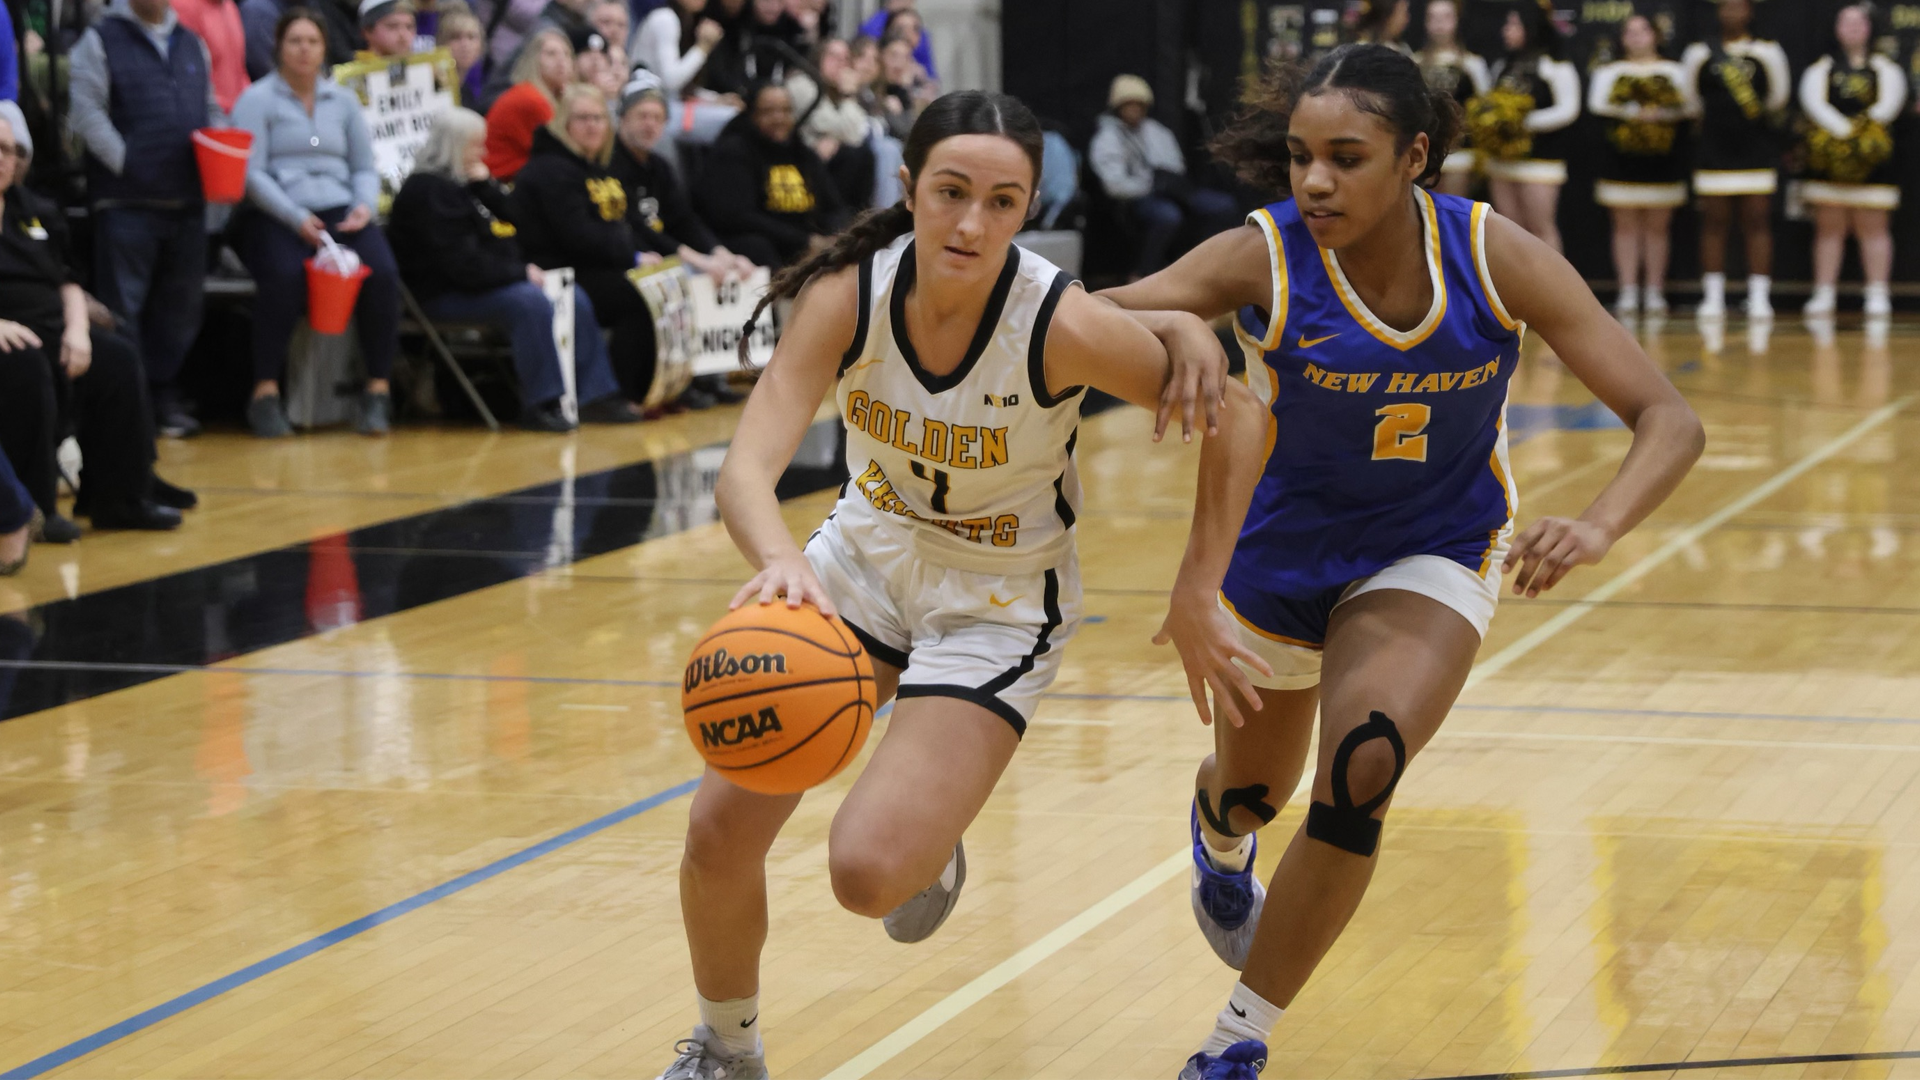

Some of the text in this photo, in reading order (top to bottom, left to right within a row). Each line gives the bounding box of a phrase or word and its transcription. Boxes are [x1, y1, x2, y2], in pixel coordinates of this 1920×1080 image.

[377, 88, 423, 114] EMILY
[1303, 354, 1501, 393] NEW HAVEN
[984, 393, 1019, 408] NE10
[846, 390, 1008, 469] GOLDEN
[1371, 403, 1431, 462] 2
[685, 648, 787, 694] Wilson
[699, 706, 783, 748] NCAA
